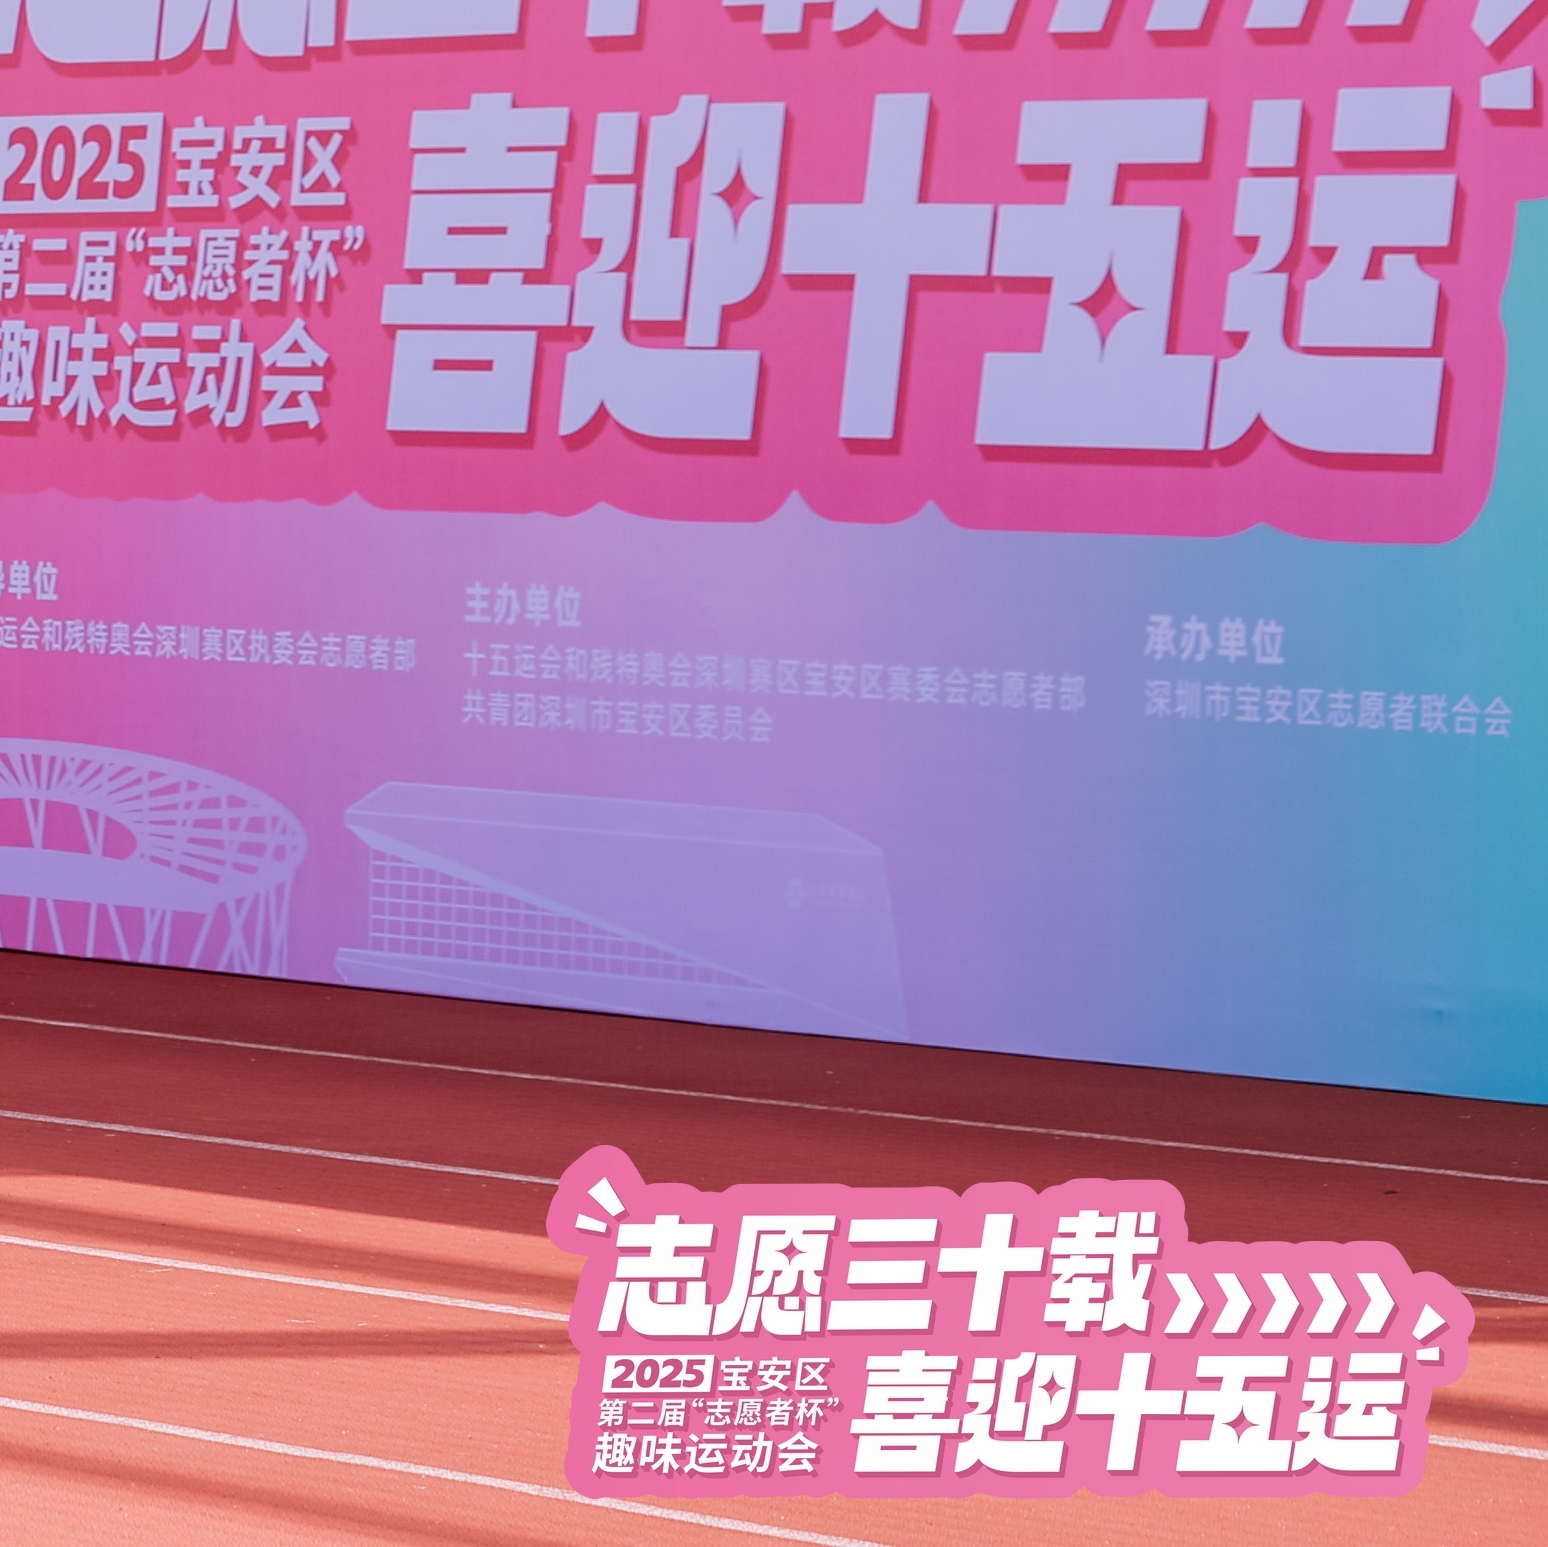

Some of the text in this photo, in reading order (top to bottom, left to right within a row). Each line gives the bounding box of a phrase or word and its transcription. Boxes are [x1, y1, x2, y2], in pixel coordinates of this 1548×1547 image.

[380, 86, 1458, 455] 喜迎十五运
[465, 582, 583, 628] 主办单位
[1144, 614, 1286, 665] 承办单位
[462, 689, 774, 744] 共青团深圳市宝安区委员会
[1144, 679, 1513, 738] 深圳市宝安区志愿者联合会
